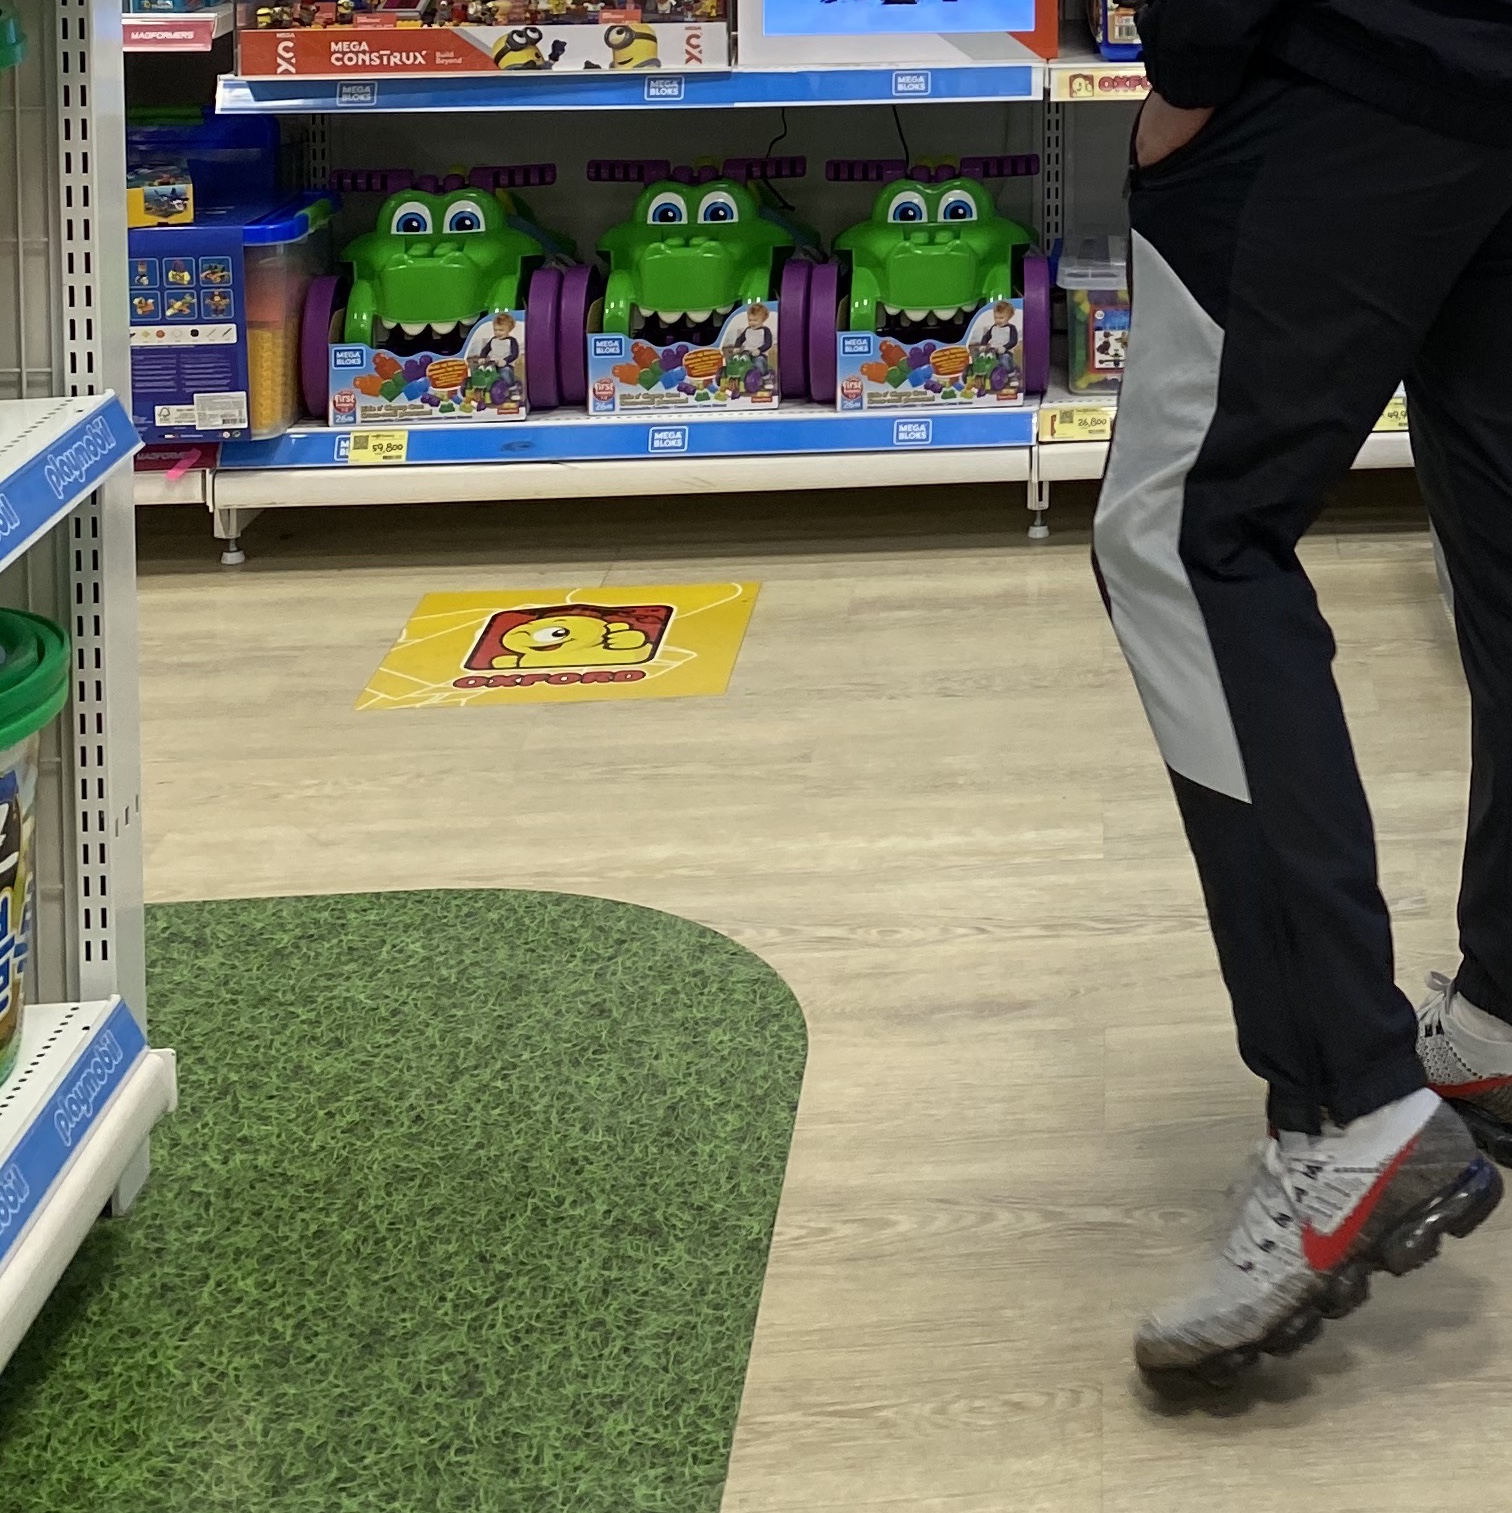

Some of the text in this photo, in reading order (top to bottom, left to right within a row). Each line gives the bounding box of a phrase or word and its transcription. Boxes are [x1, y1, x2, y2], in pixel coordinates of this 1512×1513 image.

[331, 42, 369, 52] MEGA
[331, 50, 427, 66] CONSTRUX
[649, 80, 679, 88] MEGA
[649, 88, 680, 97] BLOKS
[595, 340, 621, 348] MEGA
[595, 347, 622, 356] BLOKS
[899, 424, 926, 432] MEGA
[653, 430, 683, 440] MEGA
[899, 432, 927, 441] BLOKS
[372, 442, 403, 453] 59,800
[653, 439, 684, 450] BLOKS
[452, 669, 646, 690] OXFORD
